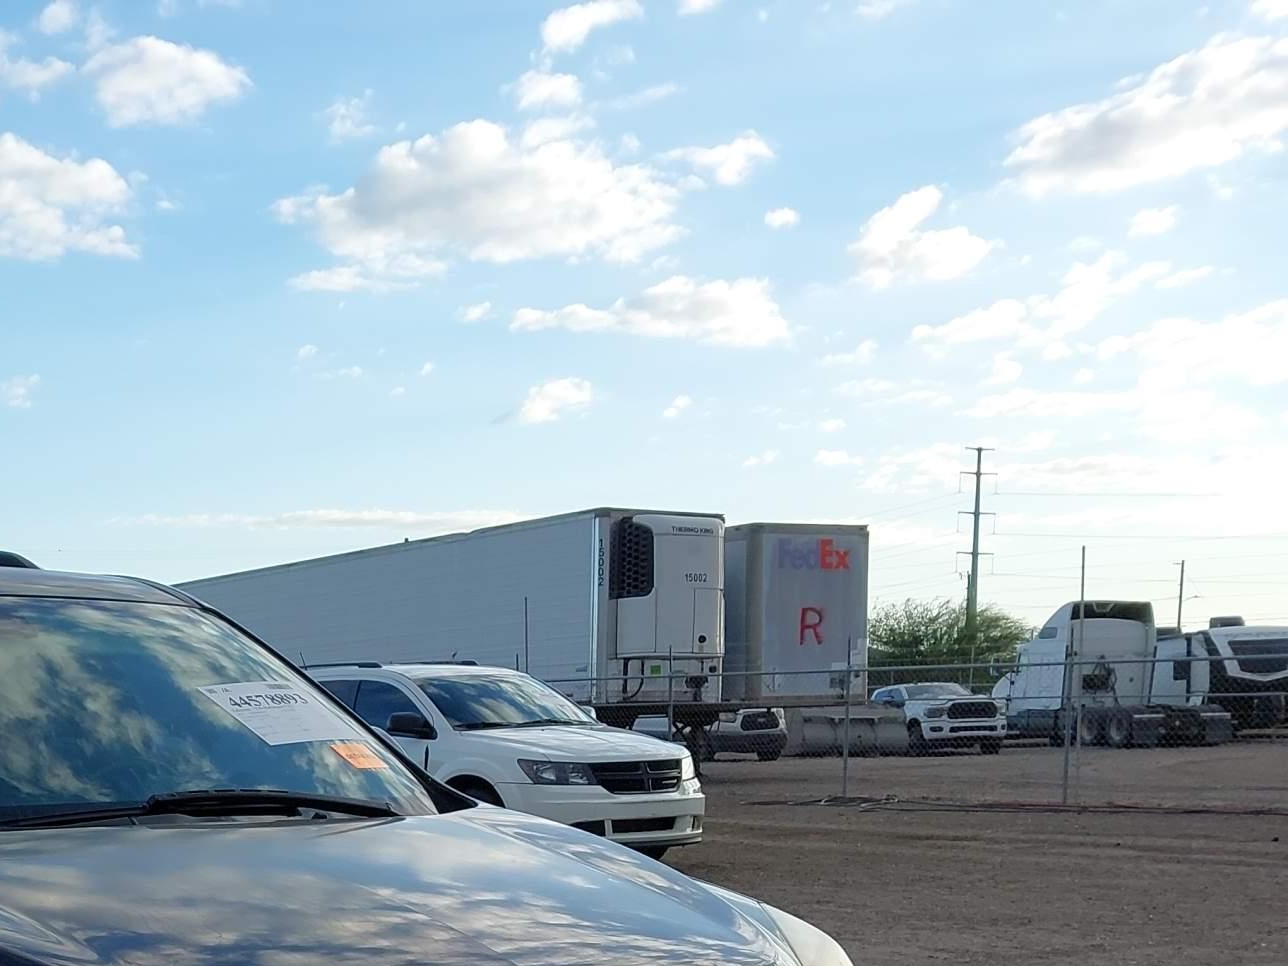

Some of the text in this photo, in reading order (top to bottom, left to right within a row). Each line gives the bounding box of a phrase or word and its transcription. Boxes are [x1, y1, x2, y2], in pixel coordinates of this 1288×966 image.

[672, 526, 699, 534] THERMO
[777, 538, 850, 569] FedEx
[684, 573, 708, 583] 15002
[799, 606, 824, 645] R
[228, 693, 309, 708] 44578893
